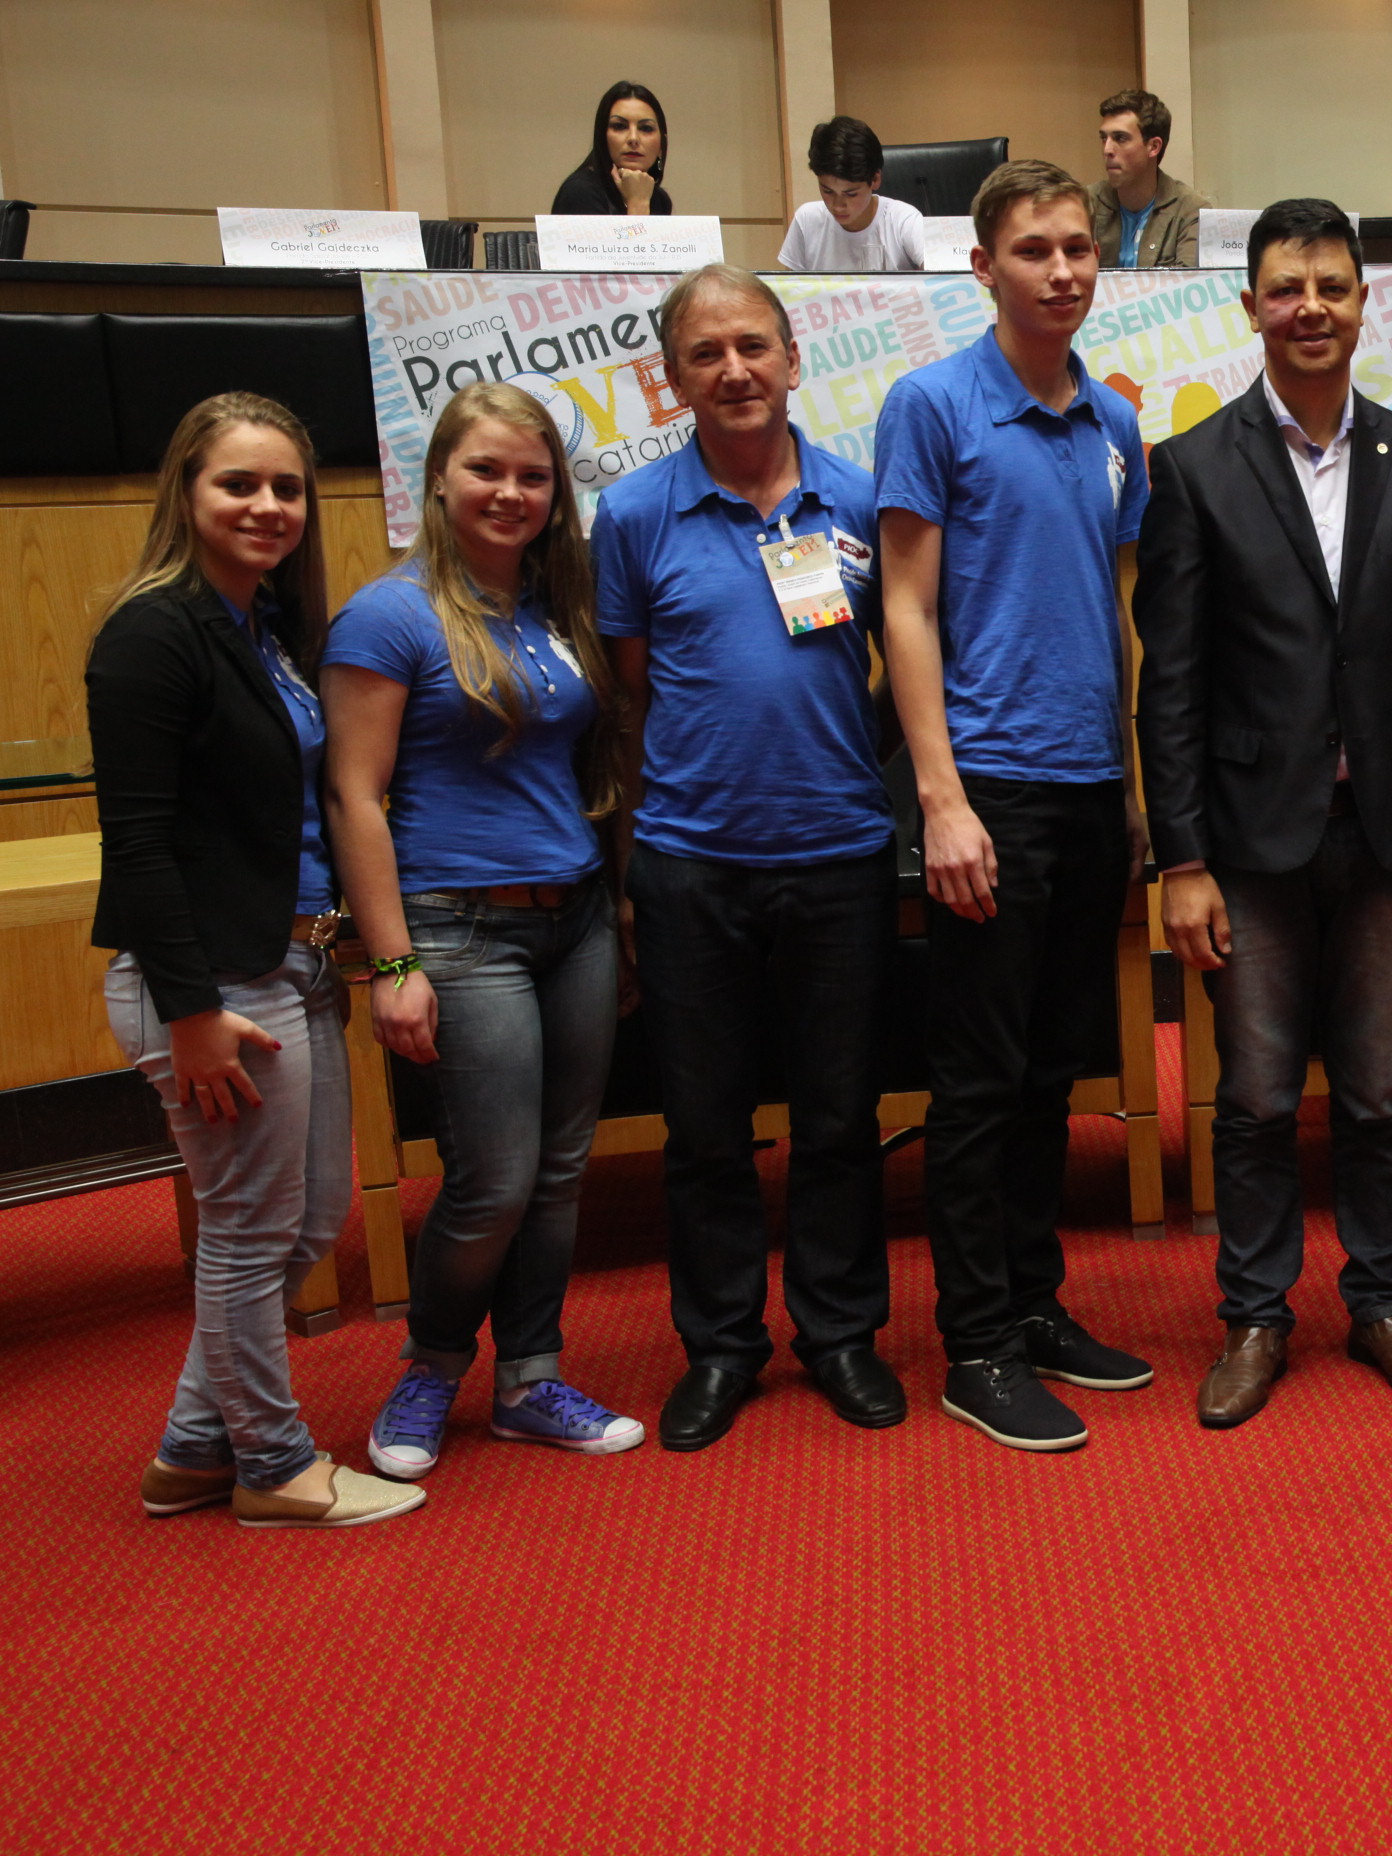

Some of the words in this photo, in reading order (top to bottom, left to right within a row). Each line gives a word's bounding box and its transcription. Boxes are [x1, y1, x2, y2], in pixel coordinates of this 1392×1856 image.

[270, 241, 314, 252] Gabriel
[317, 242, 380, 254] Gajdeczka
[567, 244, 599, 254] Maria
[602, 244, 630, 254] Luiza
[633, 244, 647, 254] de
[650, 244, 659, 254] S.
[662, 244, 697, 254] Zanolli
[1221, 240, 1244, 250] João
[392, 314, 507, 358] Programa
[800, 318, 902, 382] AÚDE
